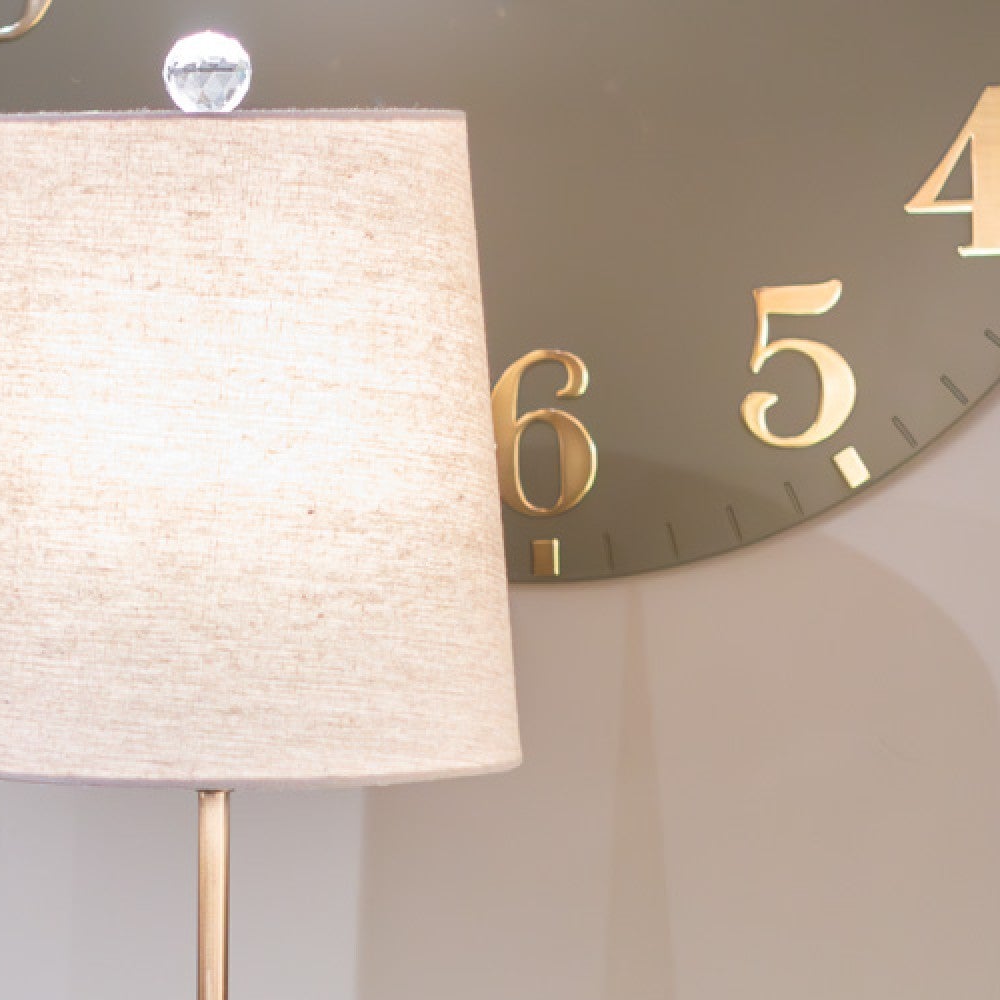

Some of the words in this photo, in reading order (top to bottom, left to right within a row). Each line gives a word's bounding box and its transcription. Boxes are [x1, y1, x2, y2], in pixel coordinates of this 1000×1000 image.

[904, 84, 1000, 257] 4
[491, 349, 597, 515] 6
[740, 279, 857, 448] 5
